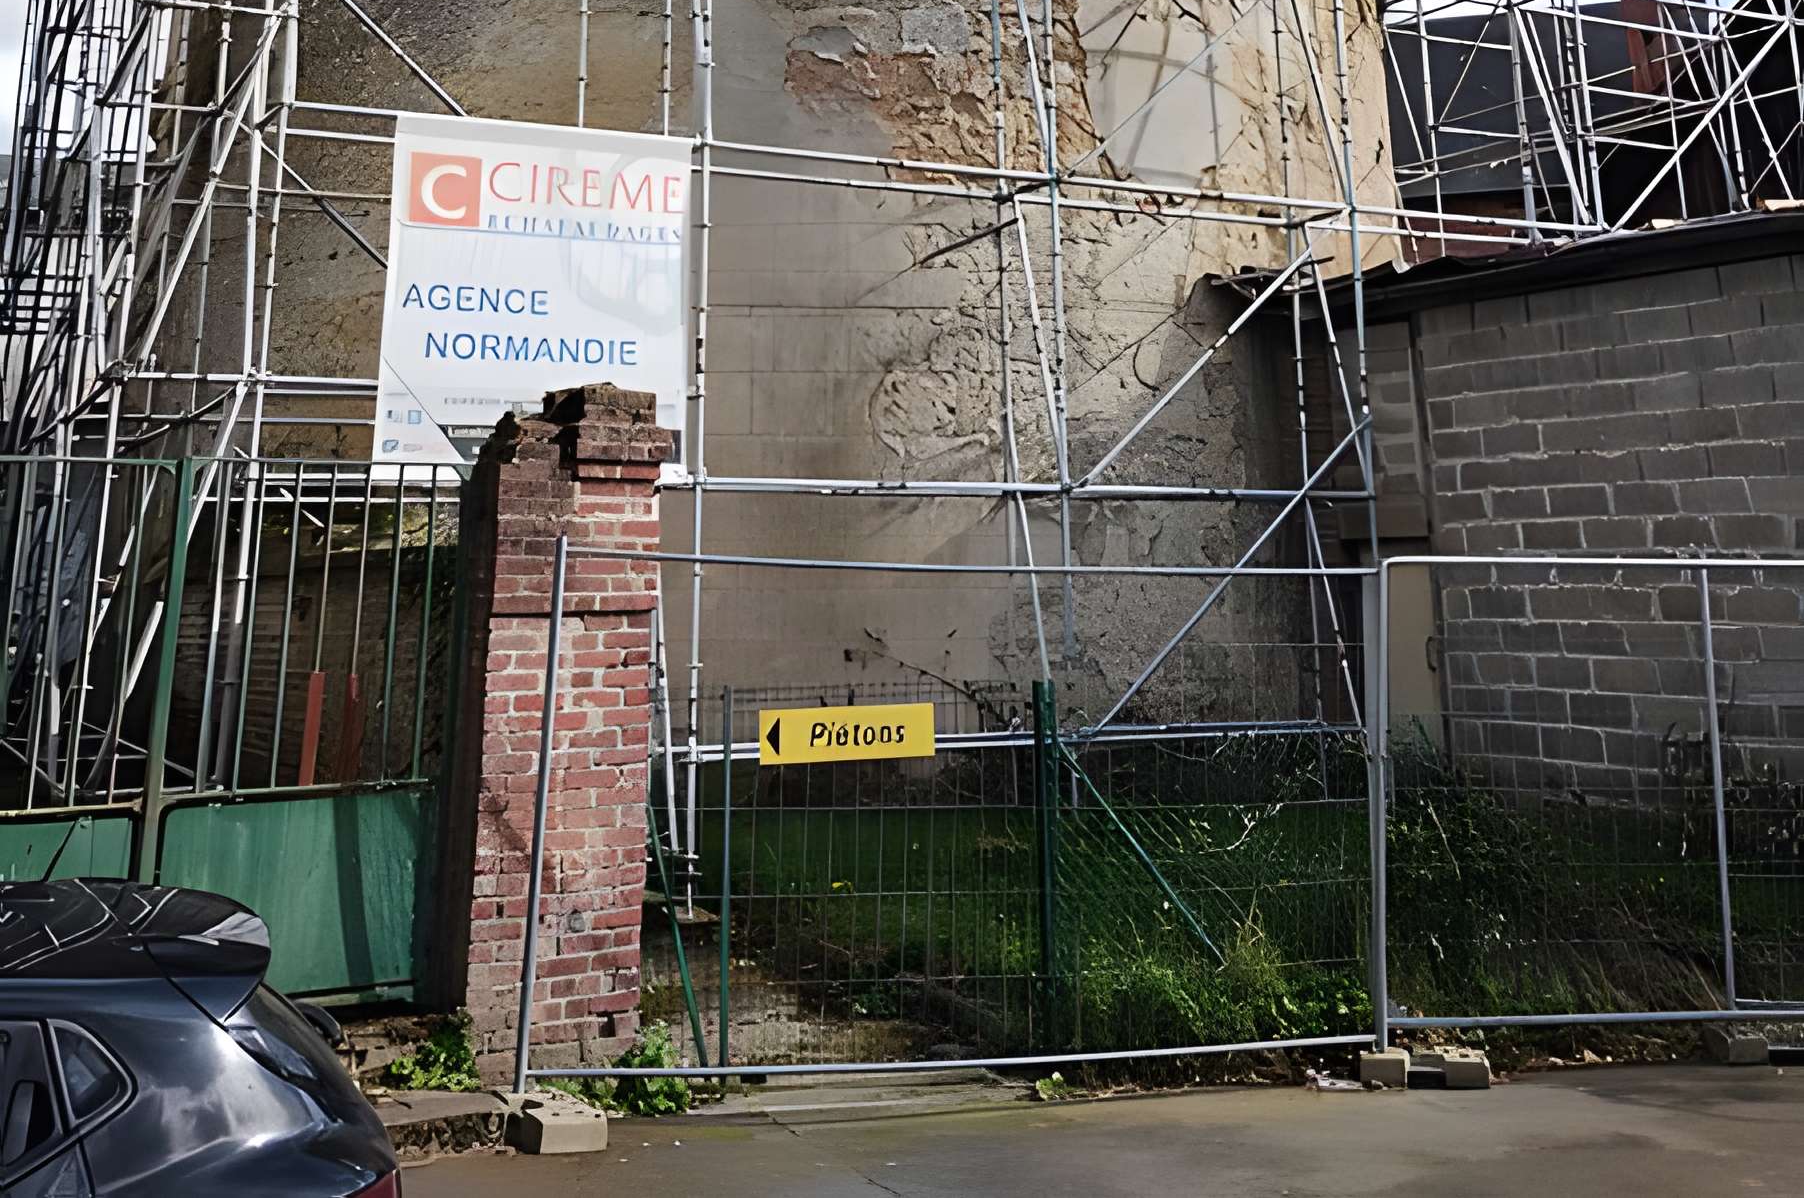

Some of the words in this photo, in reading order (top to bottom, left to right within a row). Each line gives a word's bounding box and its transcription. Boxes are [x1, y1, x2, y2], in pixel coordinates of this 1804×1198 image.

[421, 164, 467, 220] C
[489, 162, 687, 214] CIREME
[402, 283, 549, 315] AGENCE
[424, 332, 638, 366] NORMANDIE
[809, 721, 905, 747] Piétons
